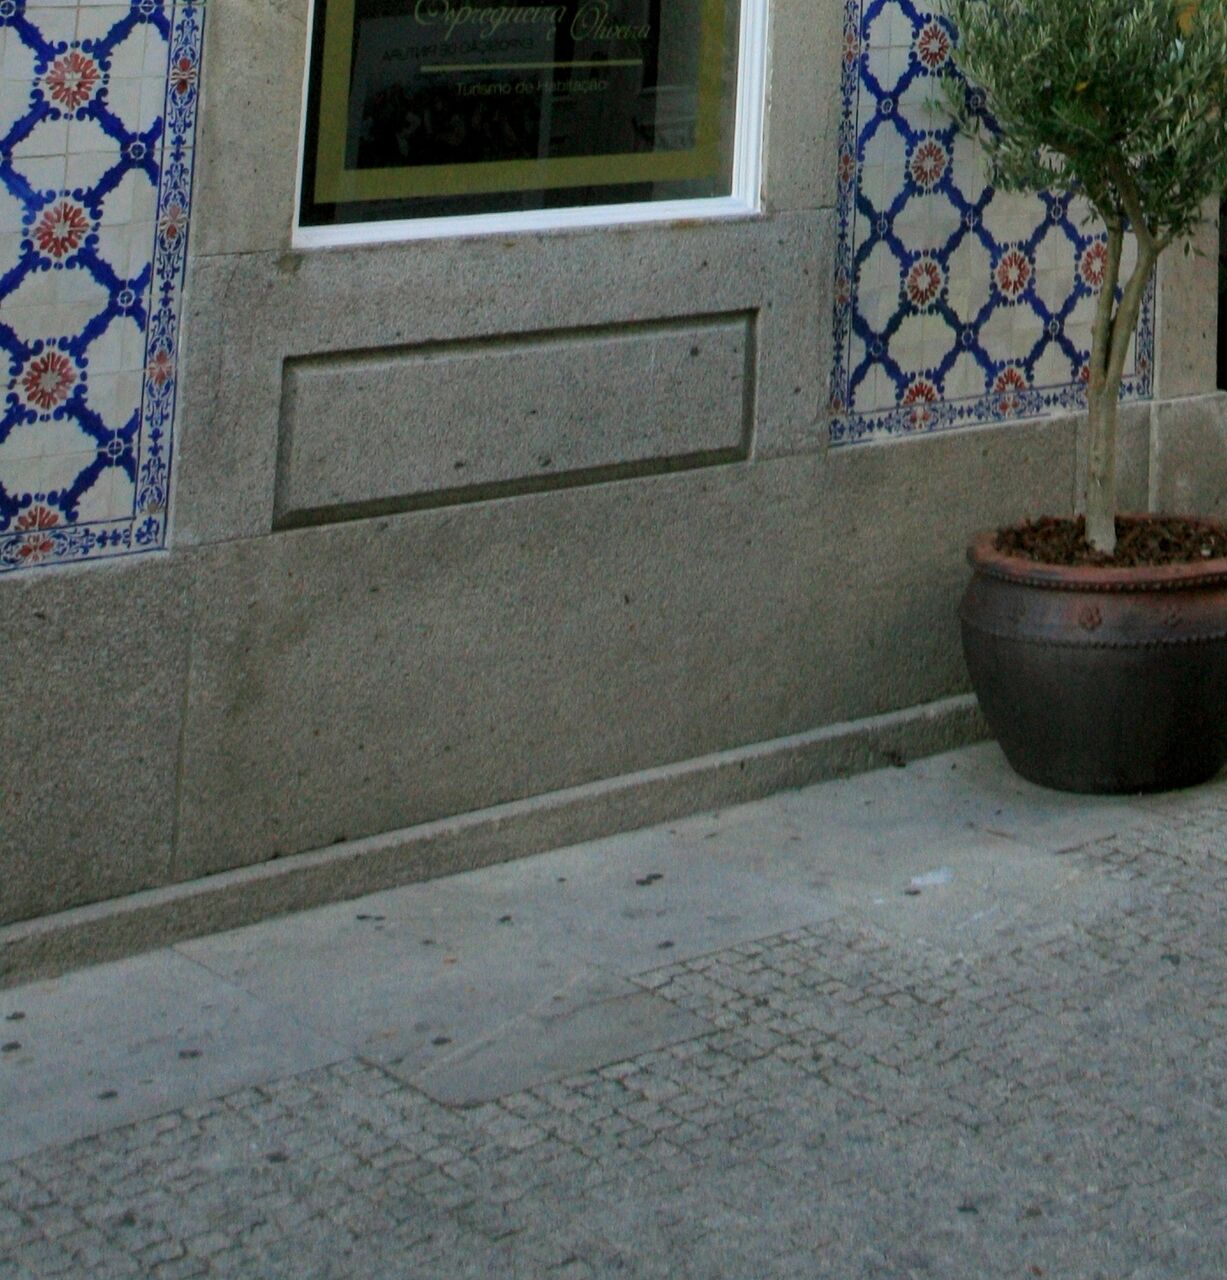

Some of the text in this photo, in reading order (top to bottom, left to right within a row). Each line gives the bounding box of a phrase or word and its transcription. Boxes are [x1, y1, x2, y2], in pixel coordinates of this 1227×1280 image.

[456, 78, 608, 97] Turismo de Habitação
